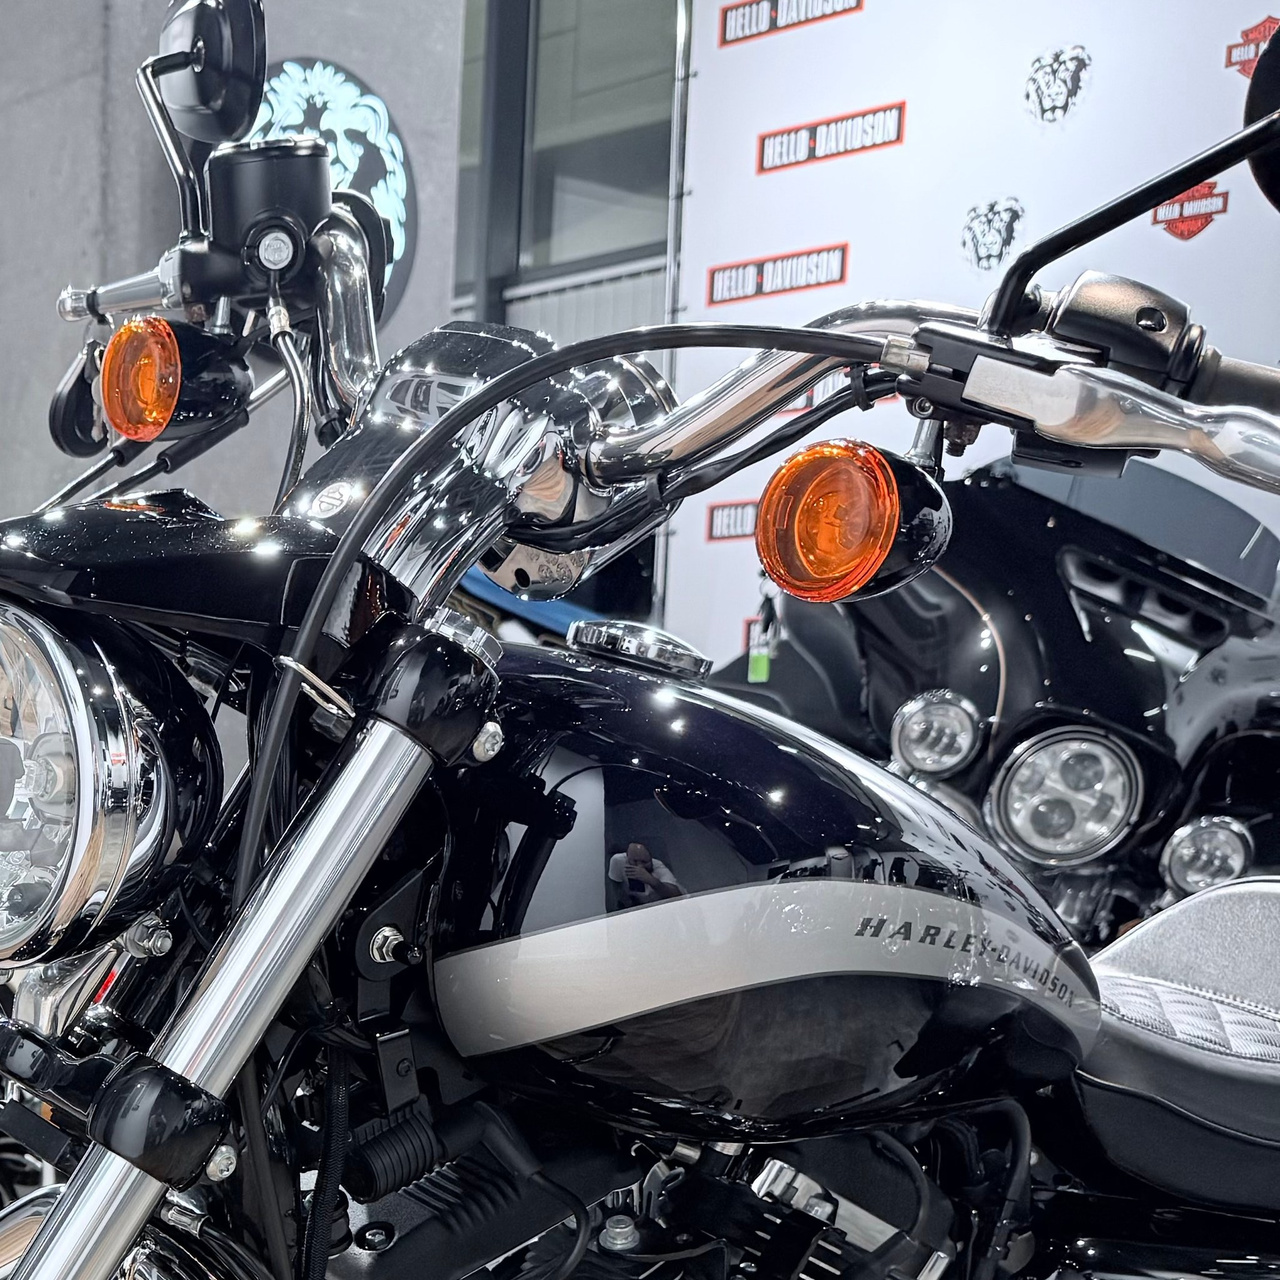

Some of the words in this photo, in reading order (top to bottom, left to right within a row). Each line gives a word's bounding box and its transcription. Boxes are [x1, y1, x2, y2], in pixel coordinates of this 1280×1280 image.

[725, 0, 770, 42] HELLO
[776, 0, 858, 28] DAVID
[762, 127, 810, 170] HELLO
[814, 107, 899, 158] DAVIDSON
[712, 263, 757, 302] HELLO
[762, 248, 844, 293] DAVIDSON
